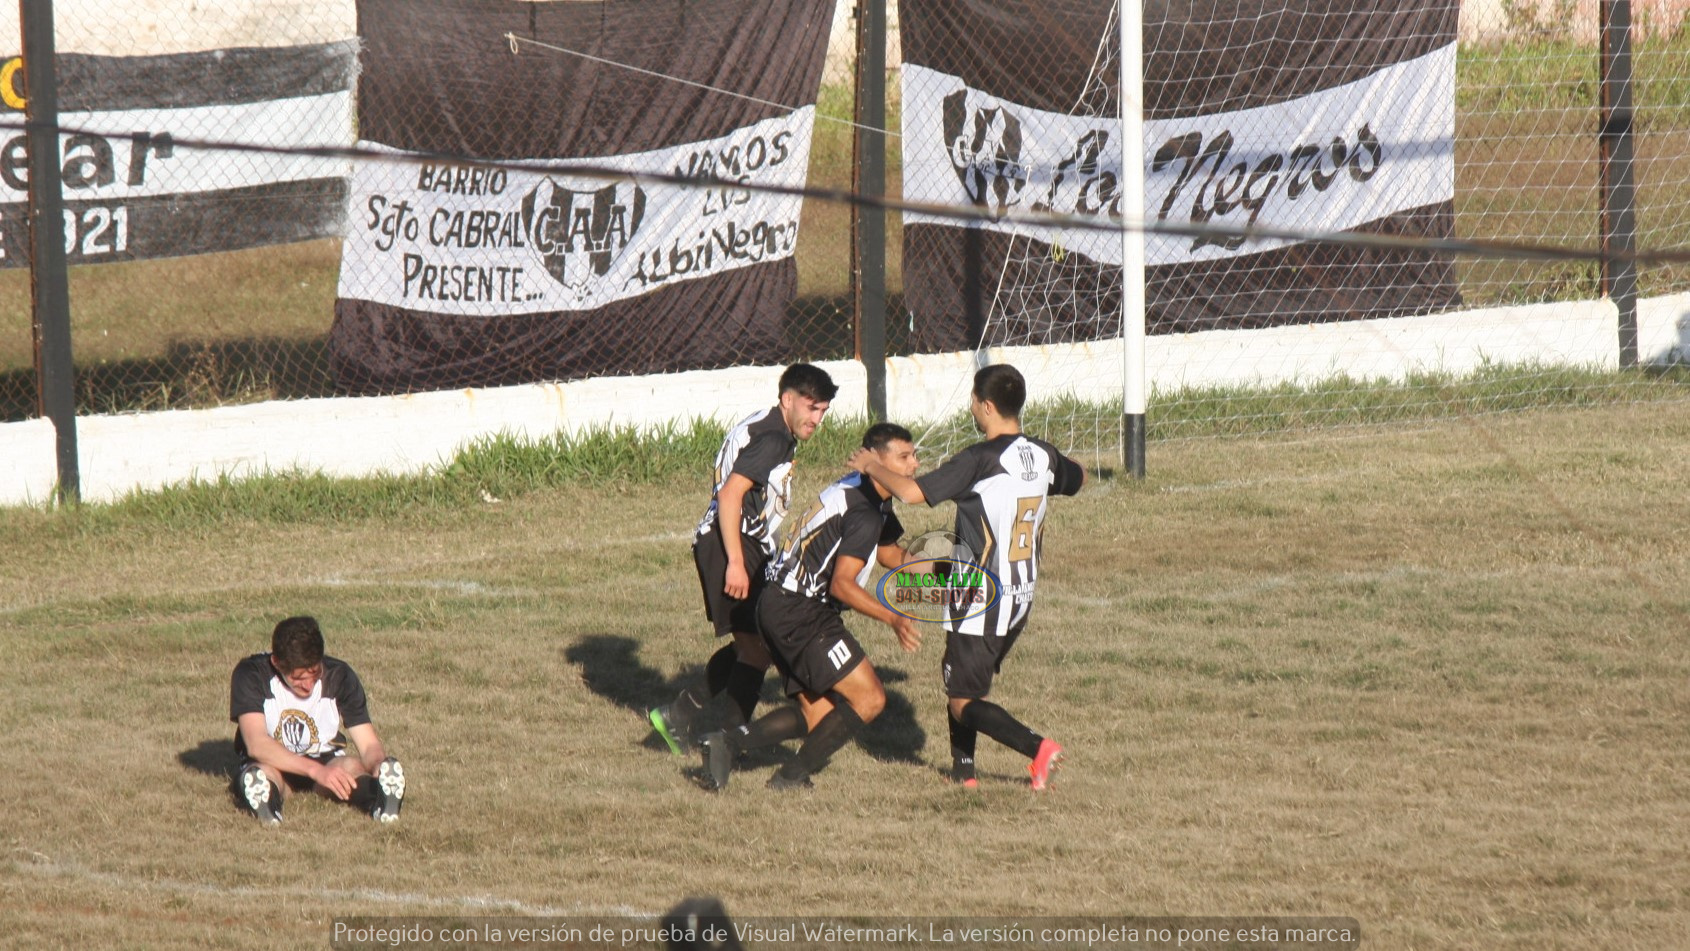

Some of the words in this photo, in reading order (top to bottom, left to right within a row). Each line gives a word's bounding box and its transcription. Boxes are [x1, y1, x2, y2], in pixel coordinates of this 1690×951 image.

[417, 163, 507, 196] BARRIO
[368, 194, 419, 251] Sgto
[429, 208, 525, 248] CABRAL
[1008, 496, 1043, 562] 6
[828, 639, 852, 671] 10
